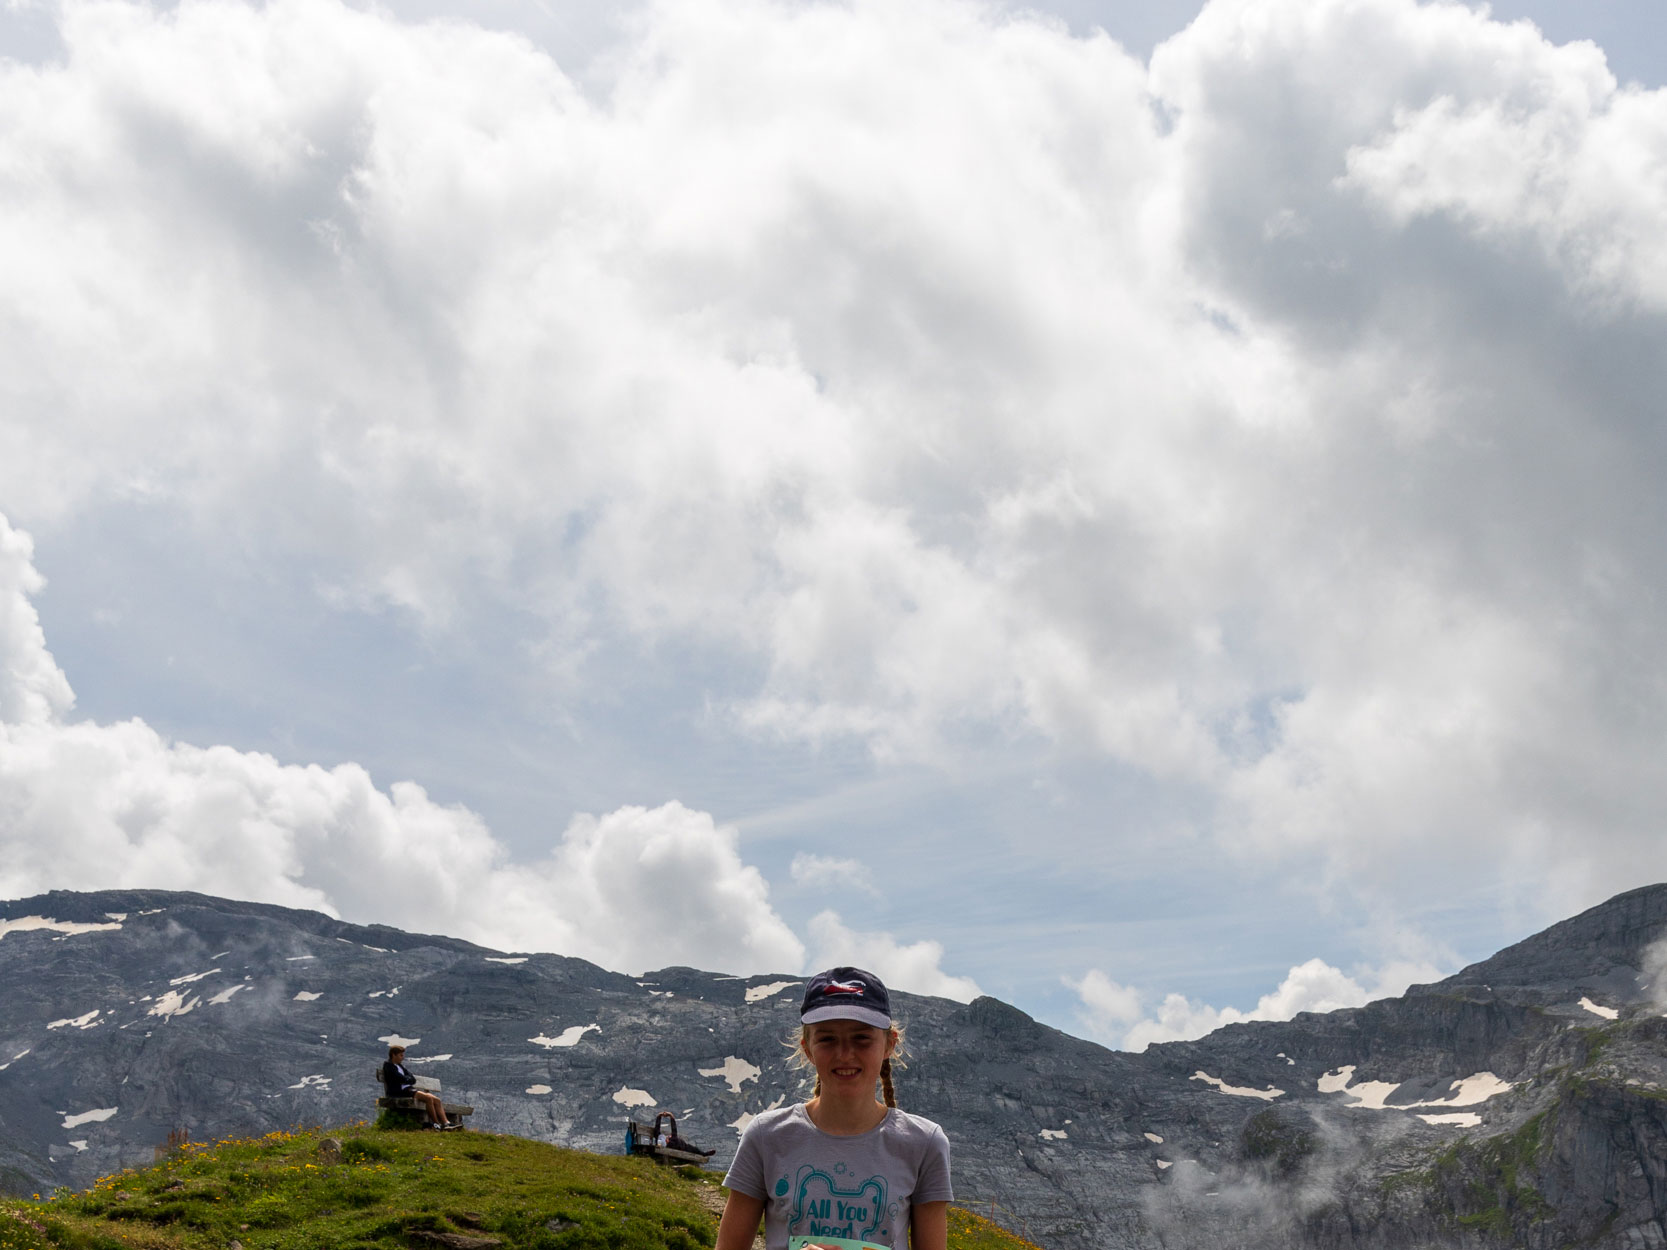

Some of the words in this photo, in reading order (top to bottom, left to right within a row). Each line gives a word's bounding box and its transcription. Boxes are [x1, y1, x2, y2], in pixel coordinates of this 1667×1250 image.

[806, 1199, 831, 1219] All
[837, 1200, 867, 1222] You
[810, 1220, 853, 1239] Need
